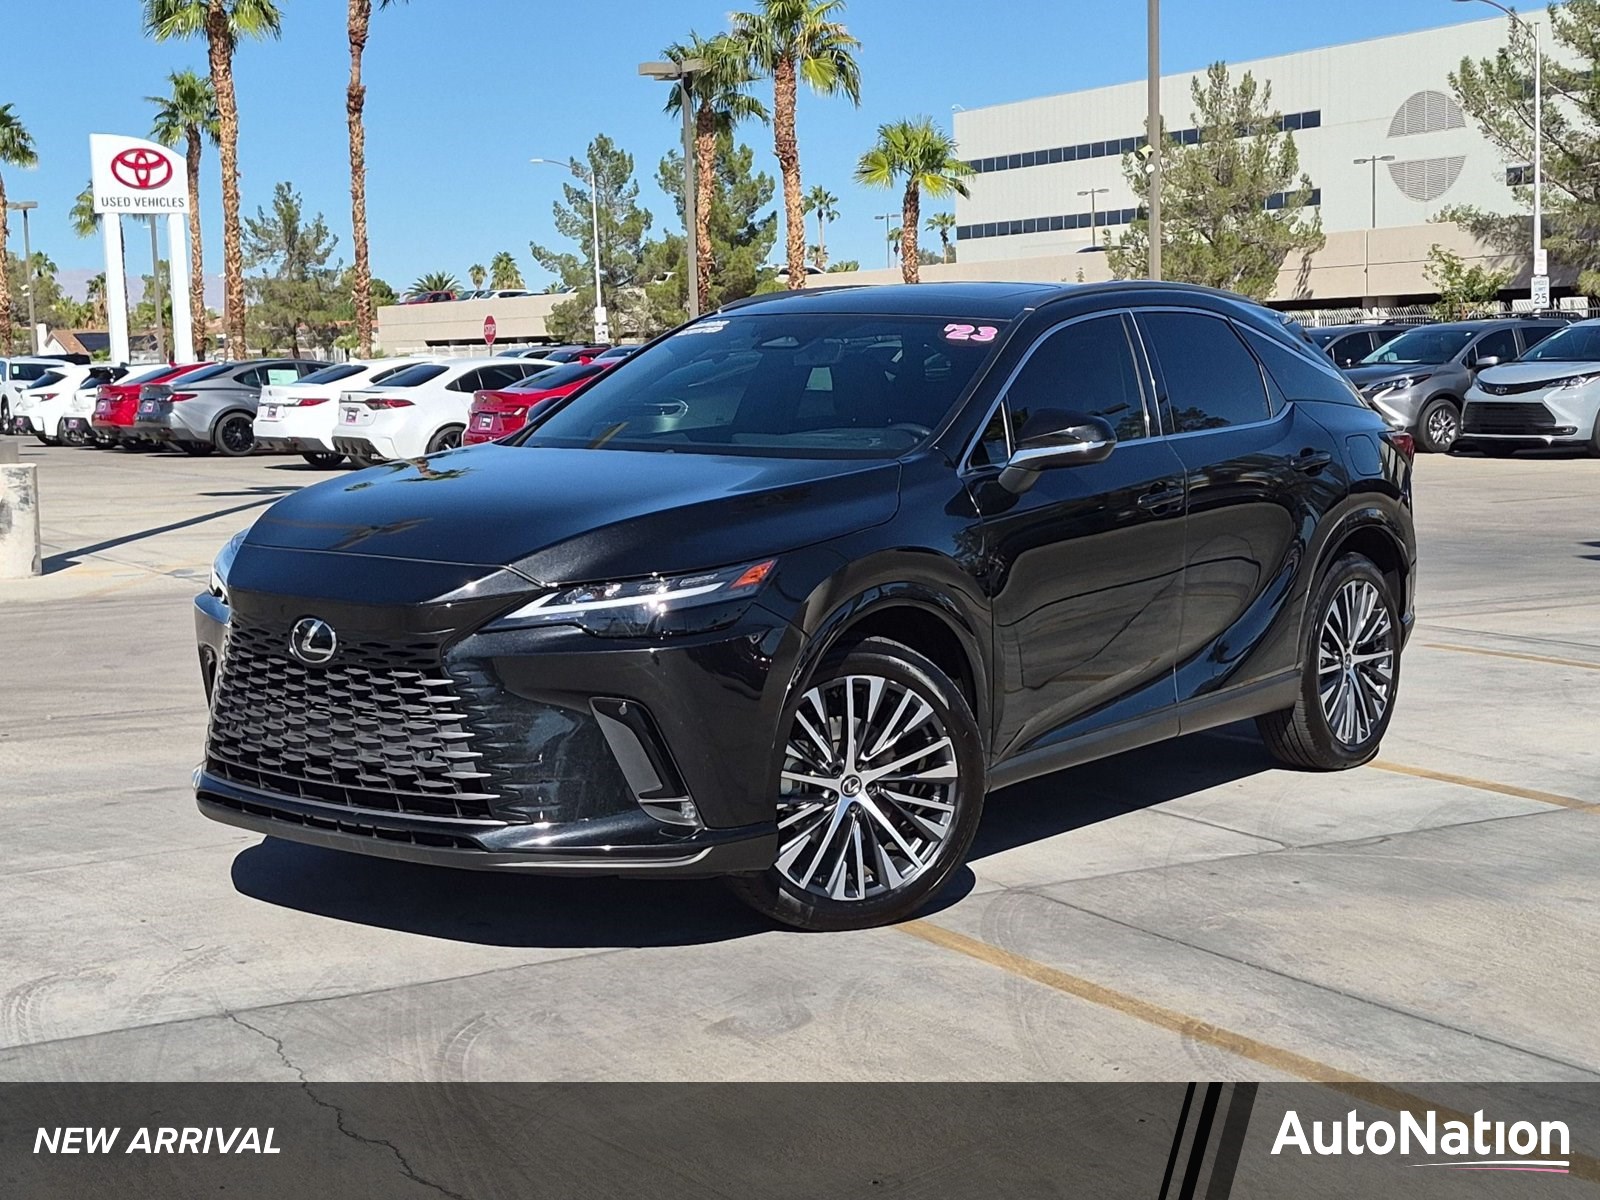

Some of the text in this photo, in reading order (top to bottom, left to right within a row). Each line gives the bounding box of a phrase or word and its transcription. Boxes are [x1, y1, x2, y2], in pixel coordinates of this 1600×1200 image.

[101, 196, 185, 208] USED VEHICLES
[1533, 293, 1547, 304] 25
